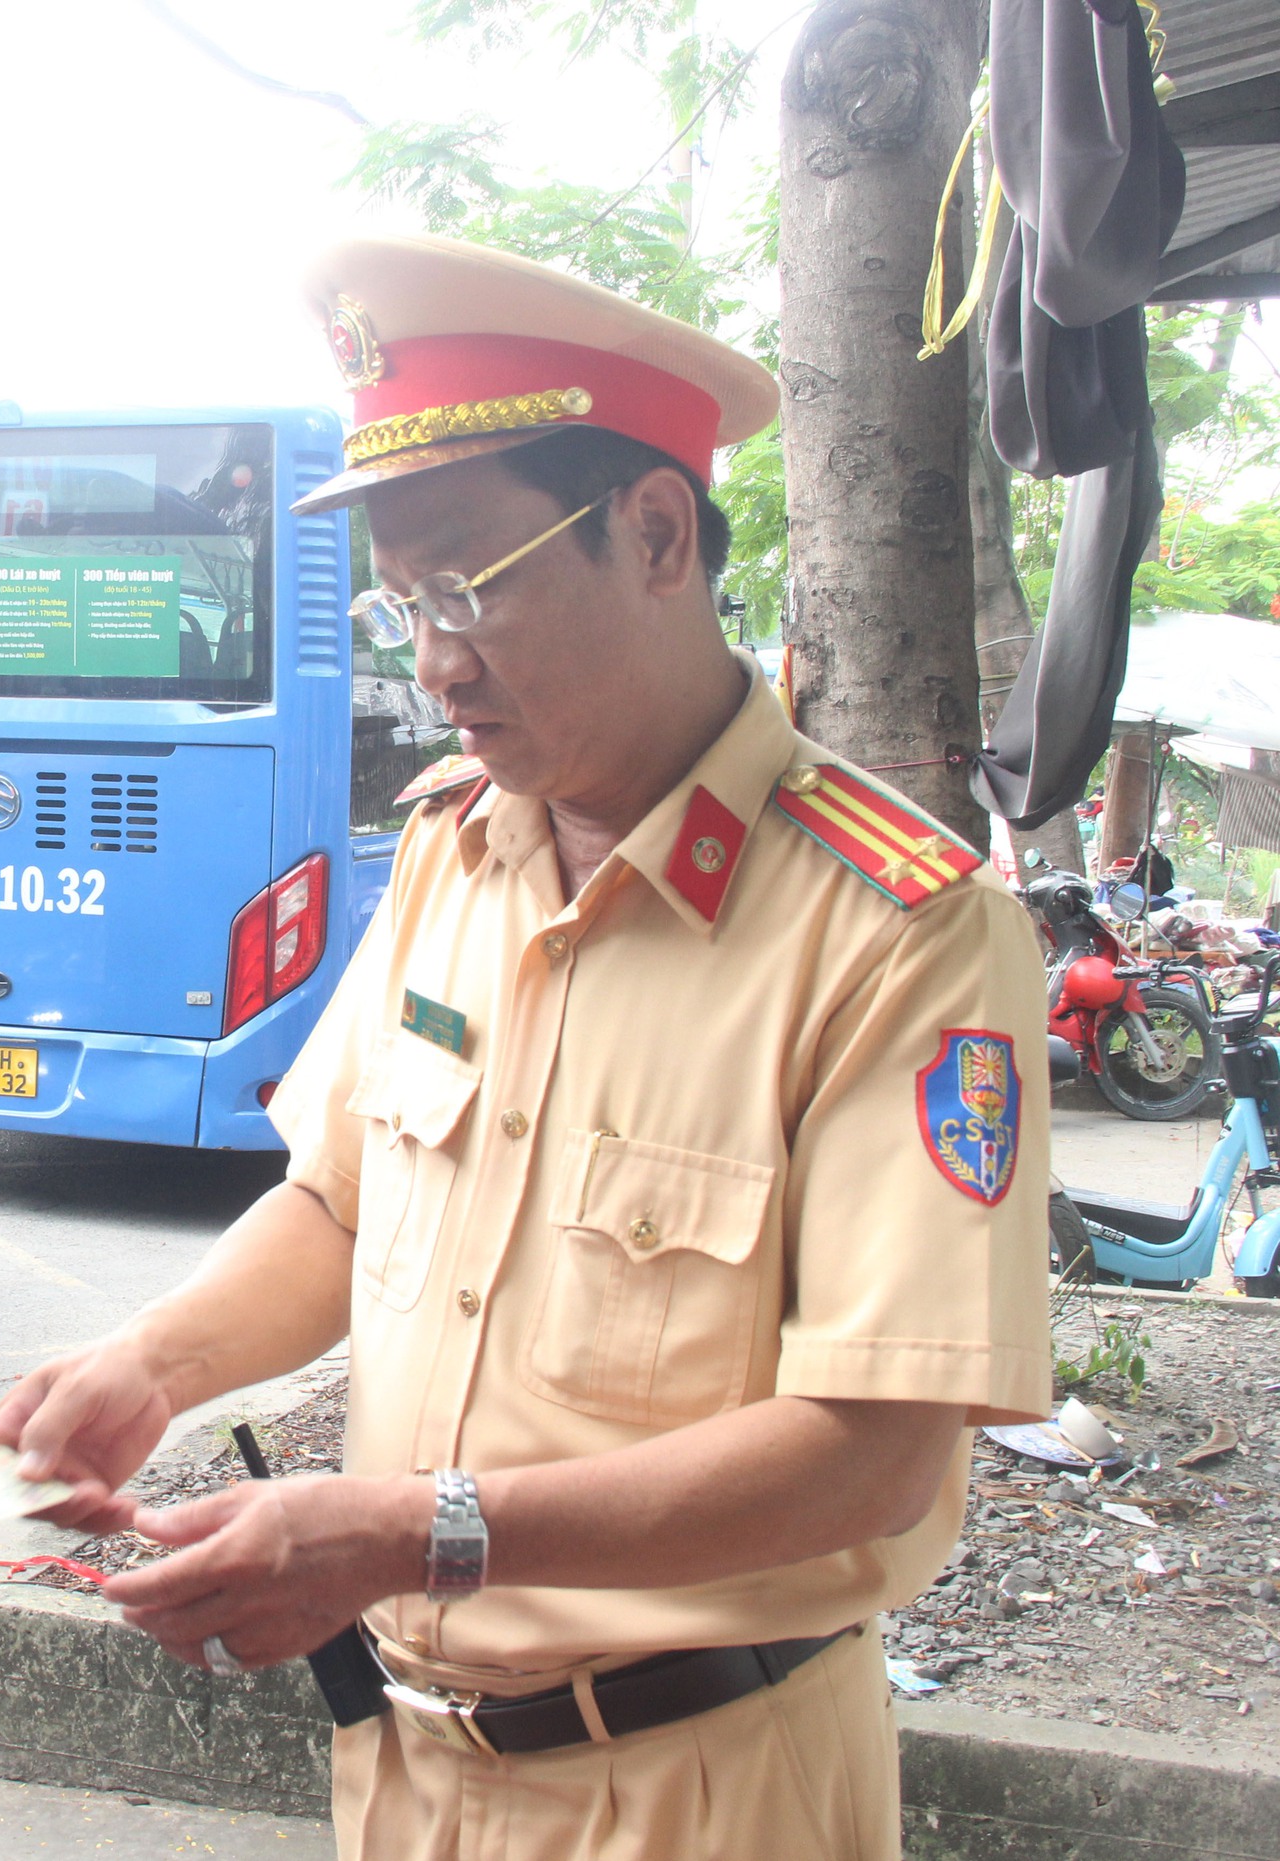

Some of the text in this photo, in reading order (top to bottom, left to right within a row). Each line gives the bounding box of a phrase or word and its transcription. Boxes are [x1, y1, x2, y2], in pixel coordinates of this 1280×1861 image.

[10, 568, 24, 580] Lái
[26, 570, 38, 580] xe
[39, 568, 61, 582] buýt
[83, 568, 174, 582] 300 Tiếp viên buýt
[939, 1118, 1013, 1151] CSGT
[1103, 1230, 1124, 1241] NEW
